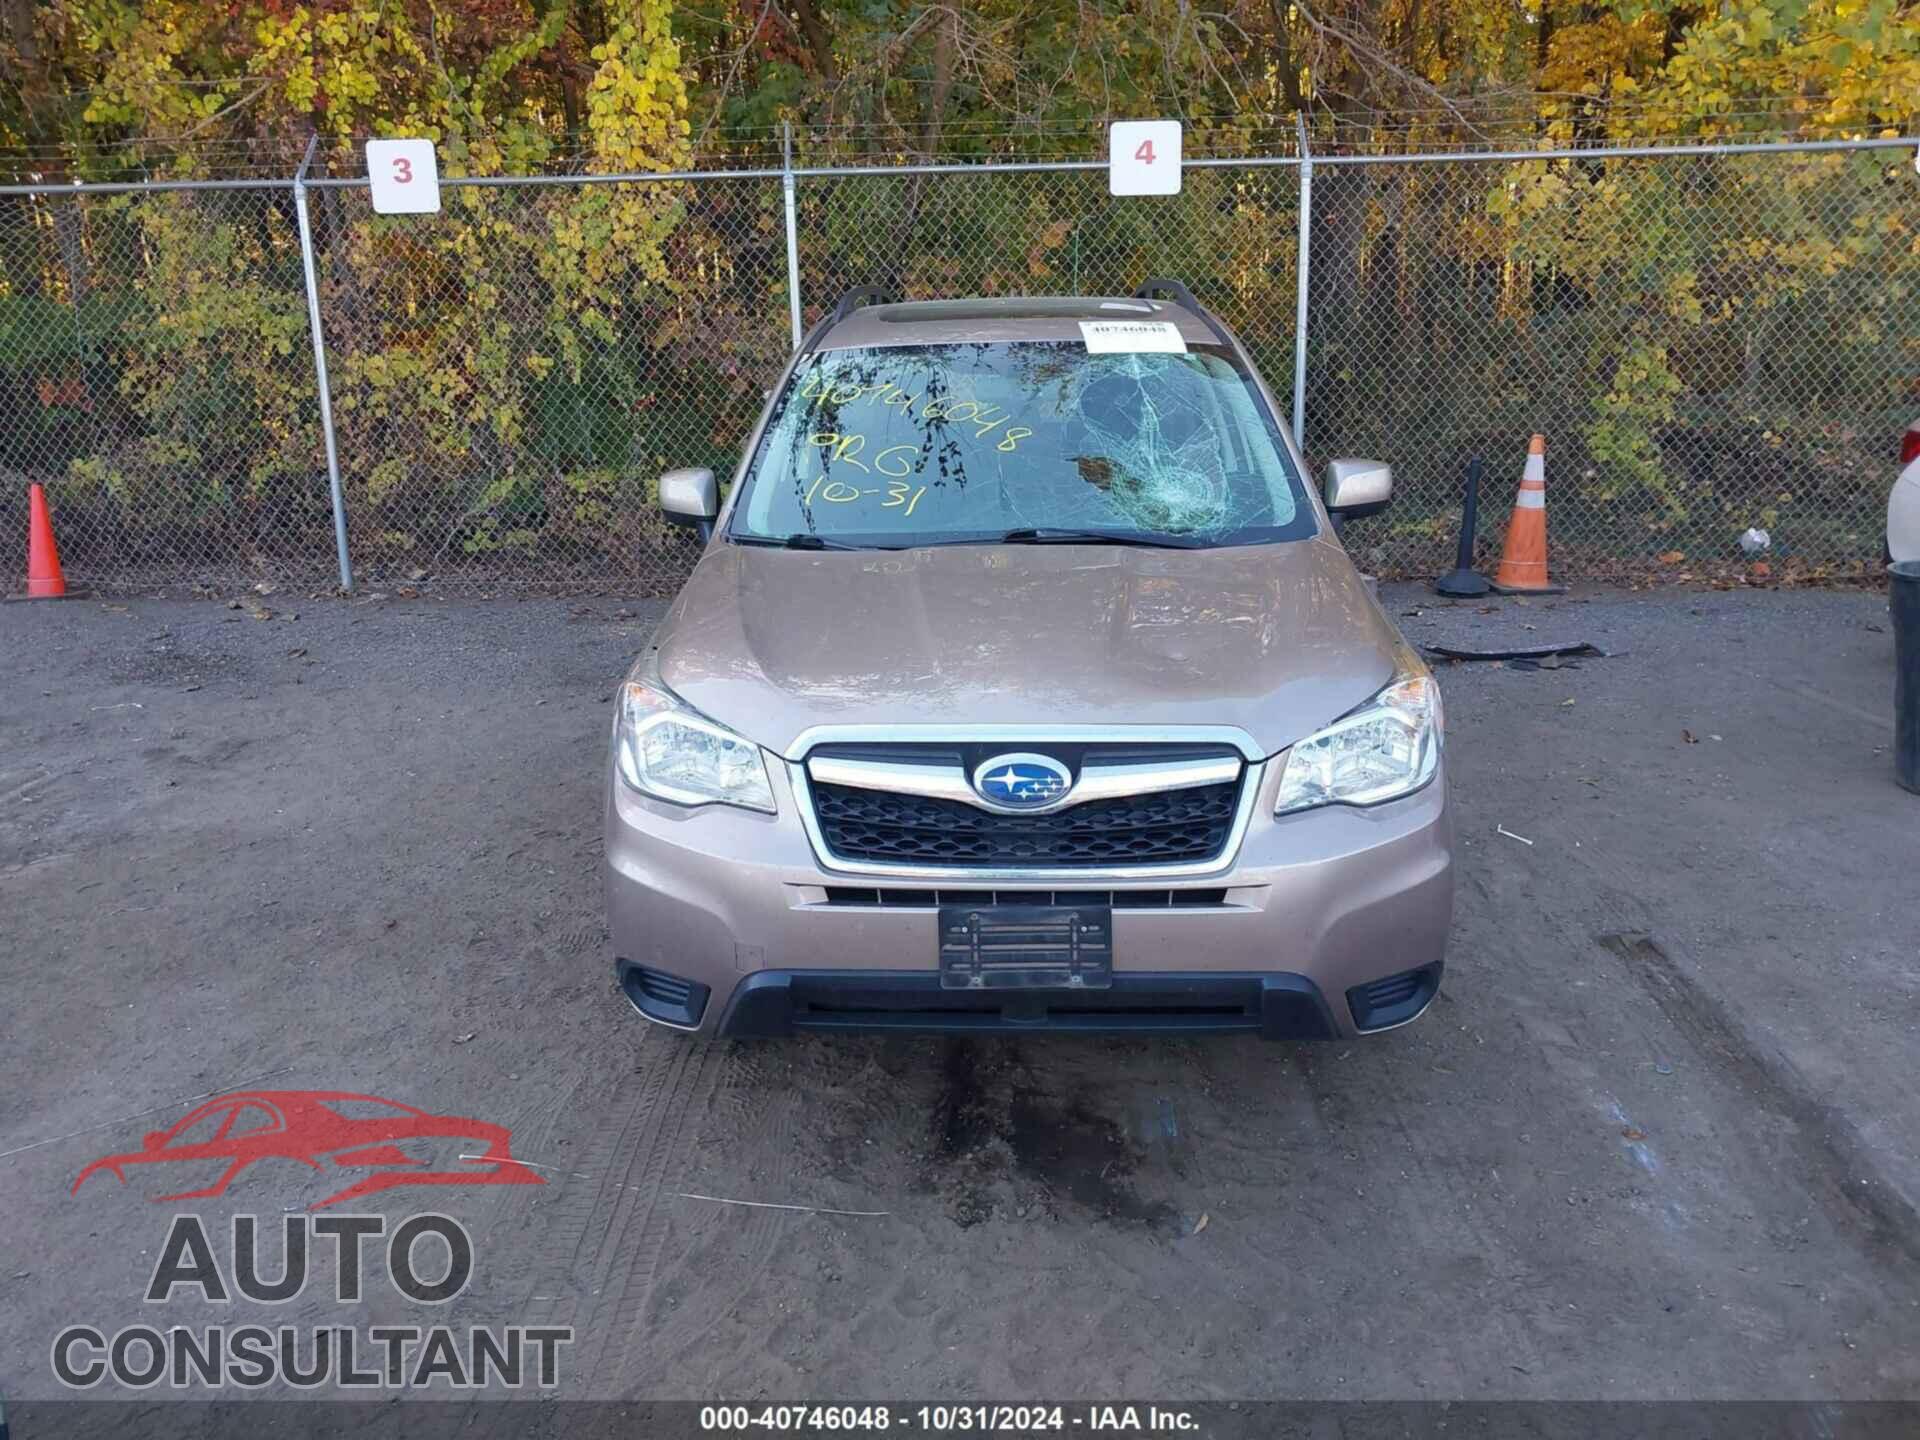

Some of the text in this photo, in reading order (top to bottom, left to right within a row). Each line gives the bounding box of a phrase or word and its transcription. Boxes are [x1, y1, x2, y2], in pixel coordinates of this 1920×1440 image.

[1134, 139, 1157, 165] 4
[392, 157, 413, 184] 3
[801, 376, 1032, 451] 40746048
[805, 475, 927, 516] 10-31
